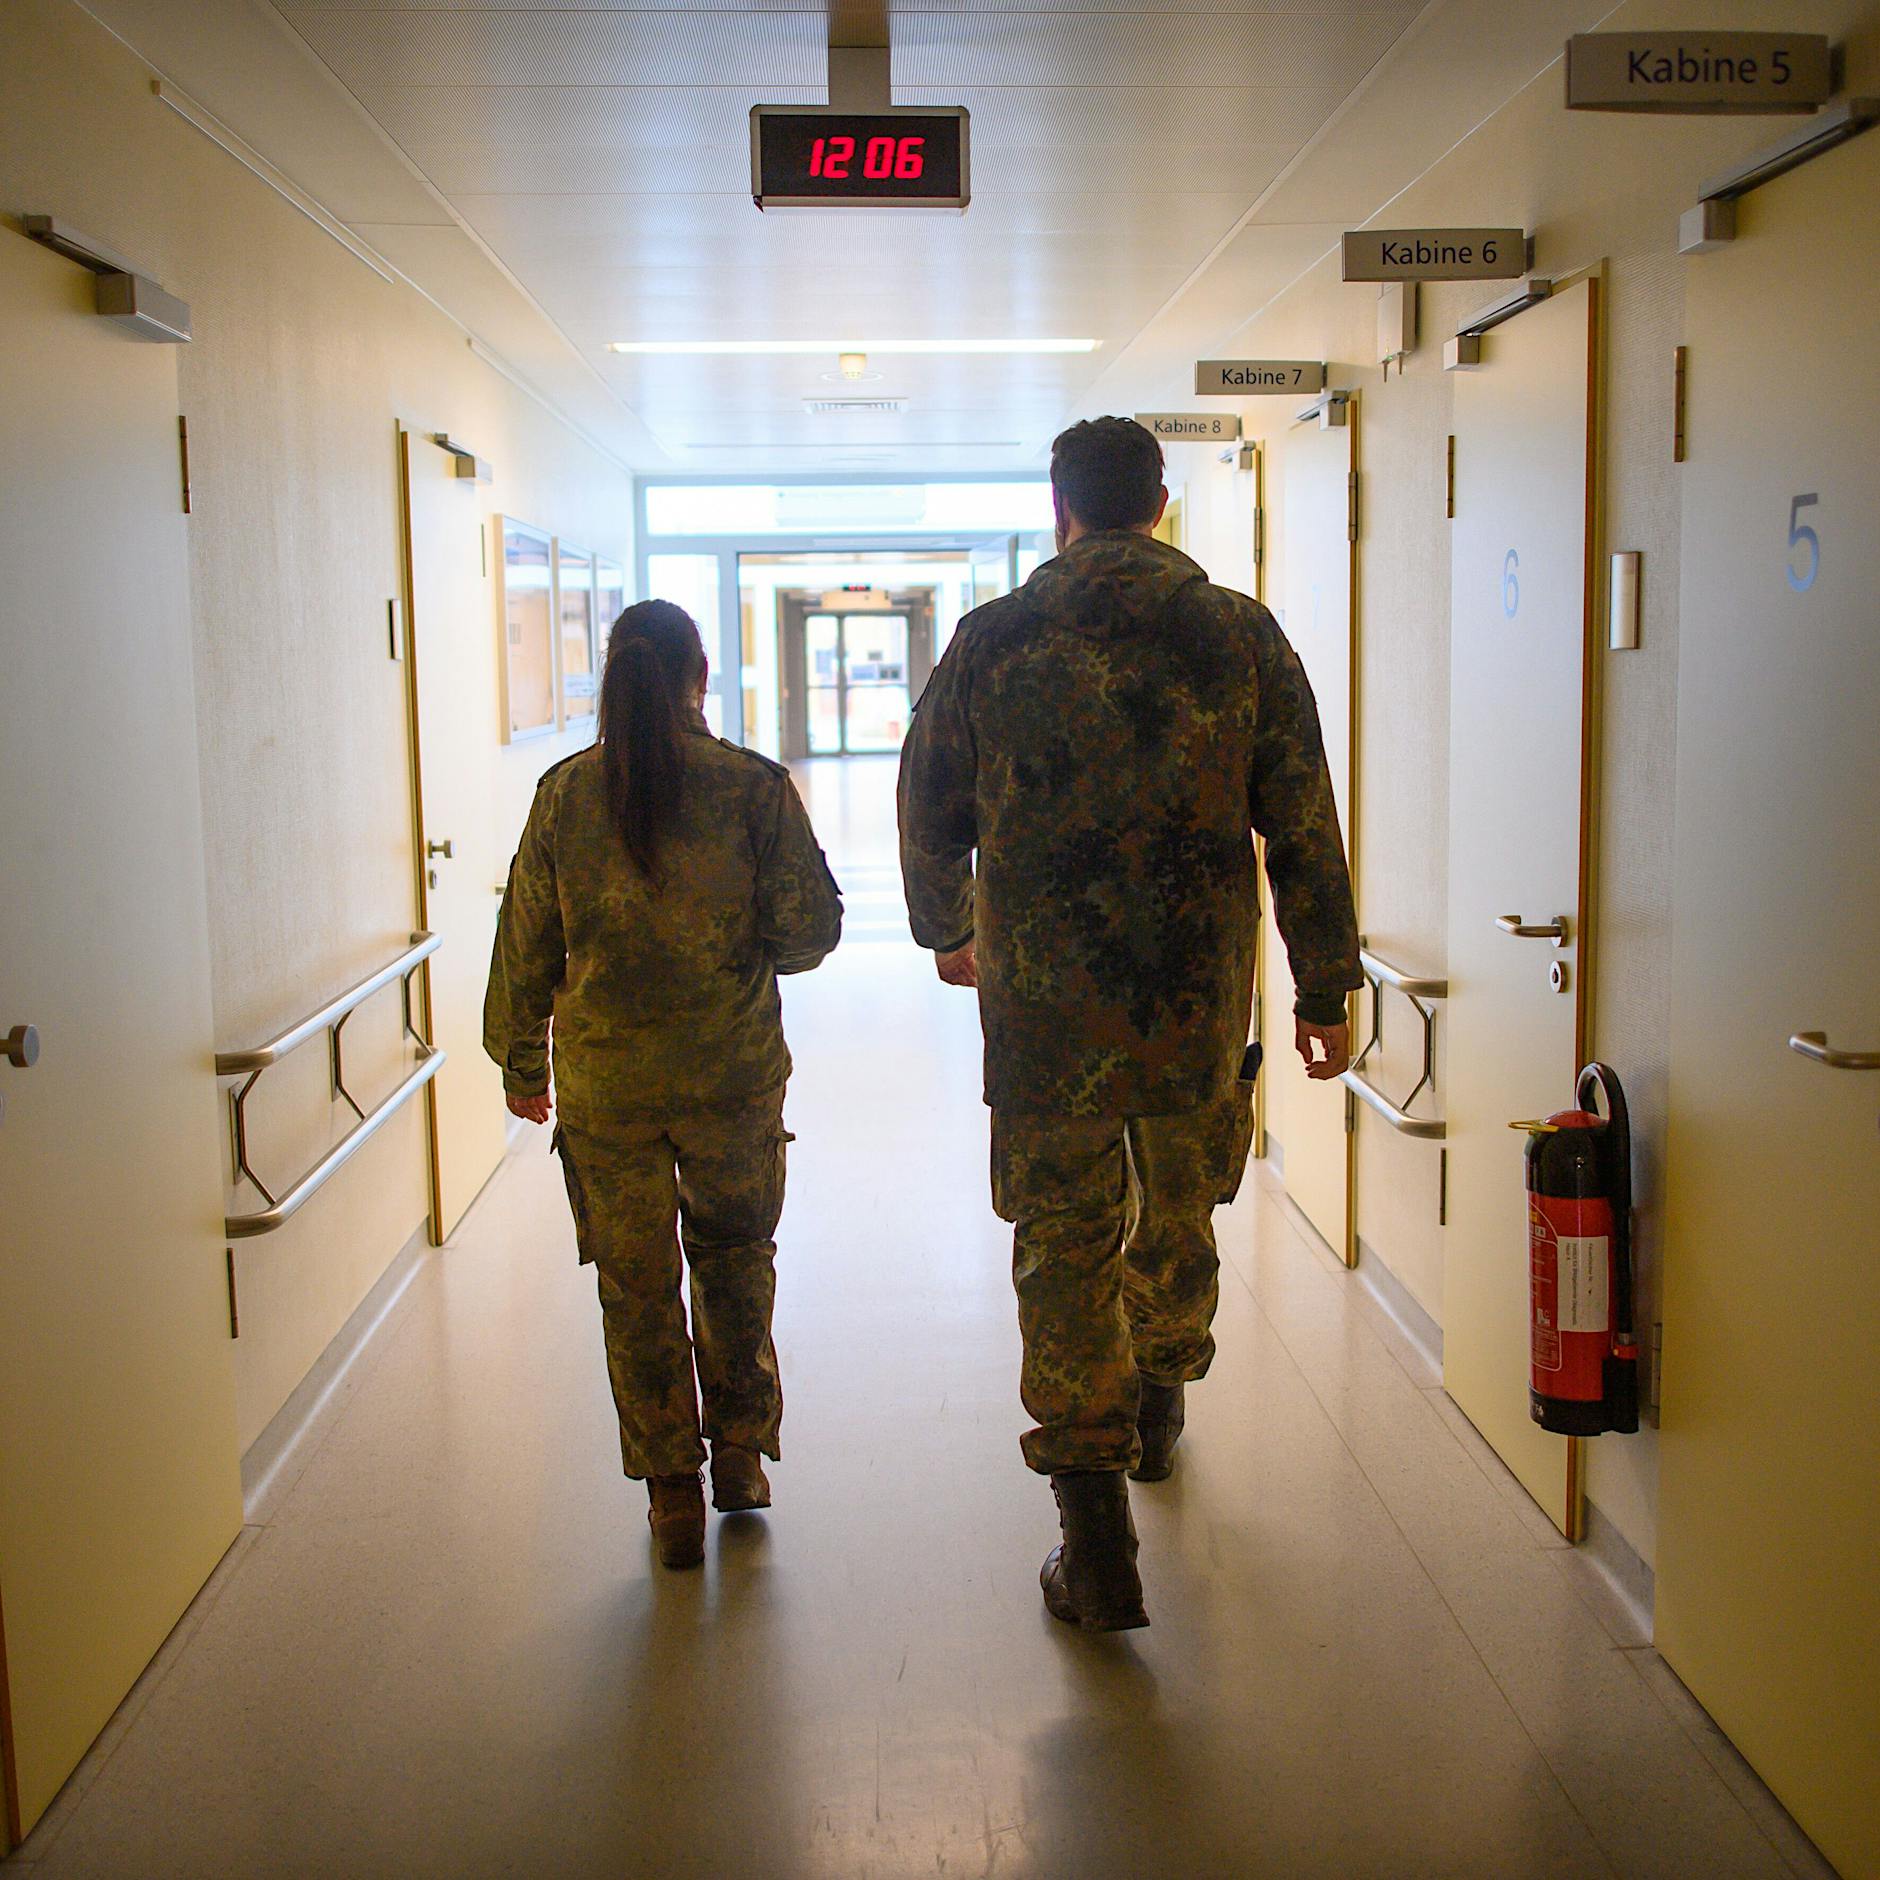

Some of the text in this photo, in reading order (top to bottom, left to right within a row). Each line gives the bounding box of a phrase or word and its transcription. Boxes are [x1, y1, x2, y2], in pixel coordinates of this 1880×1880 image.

[1628, 48, 1790, 85] Kabine 5
[810, 136, 925, 179] 12 06
[1382, 240, 1497, 265] Kabine 6
[1222, 368, 1303, 385] Kabine 7
[1154, 419, 1221, 433] Kabine 8
[1785, 492, 1820, 593] 5
[1503, 548, 1520, 619] 6
